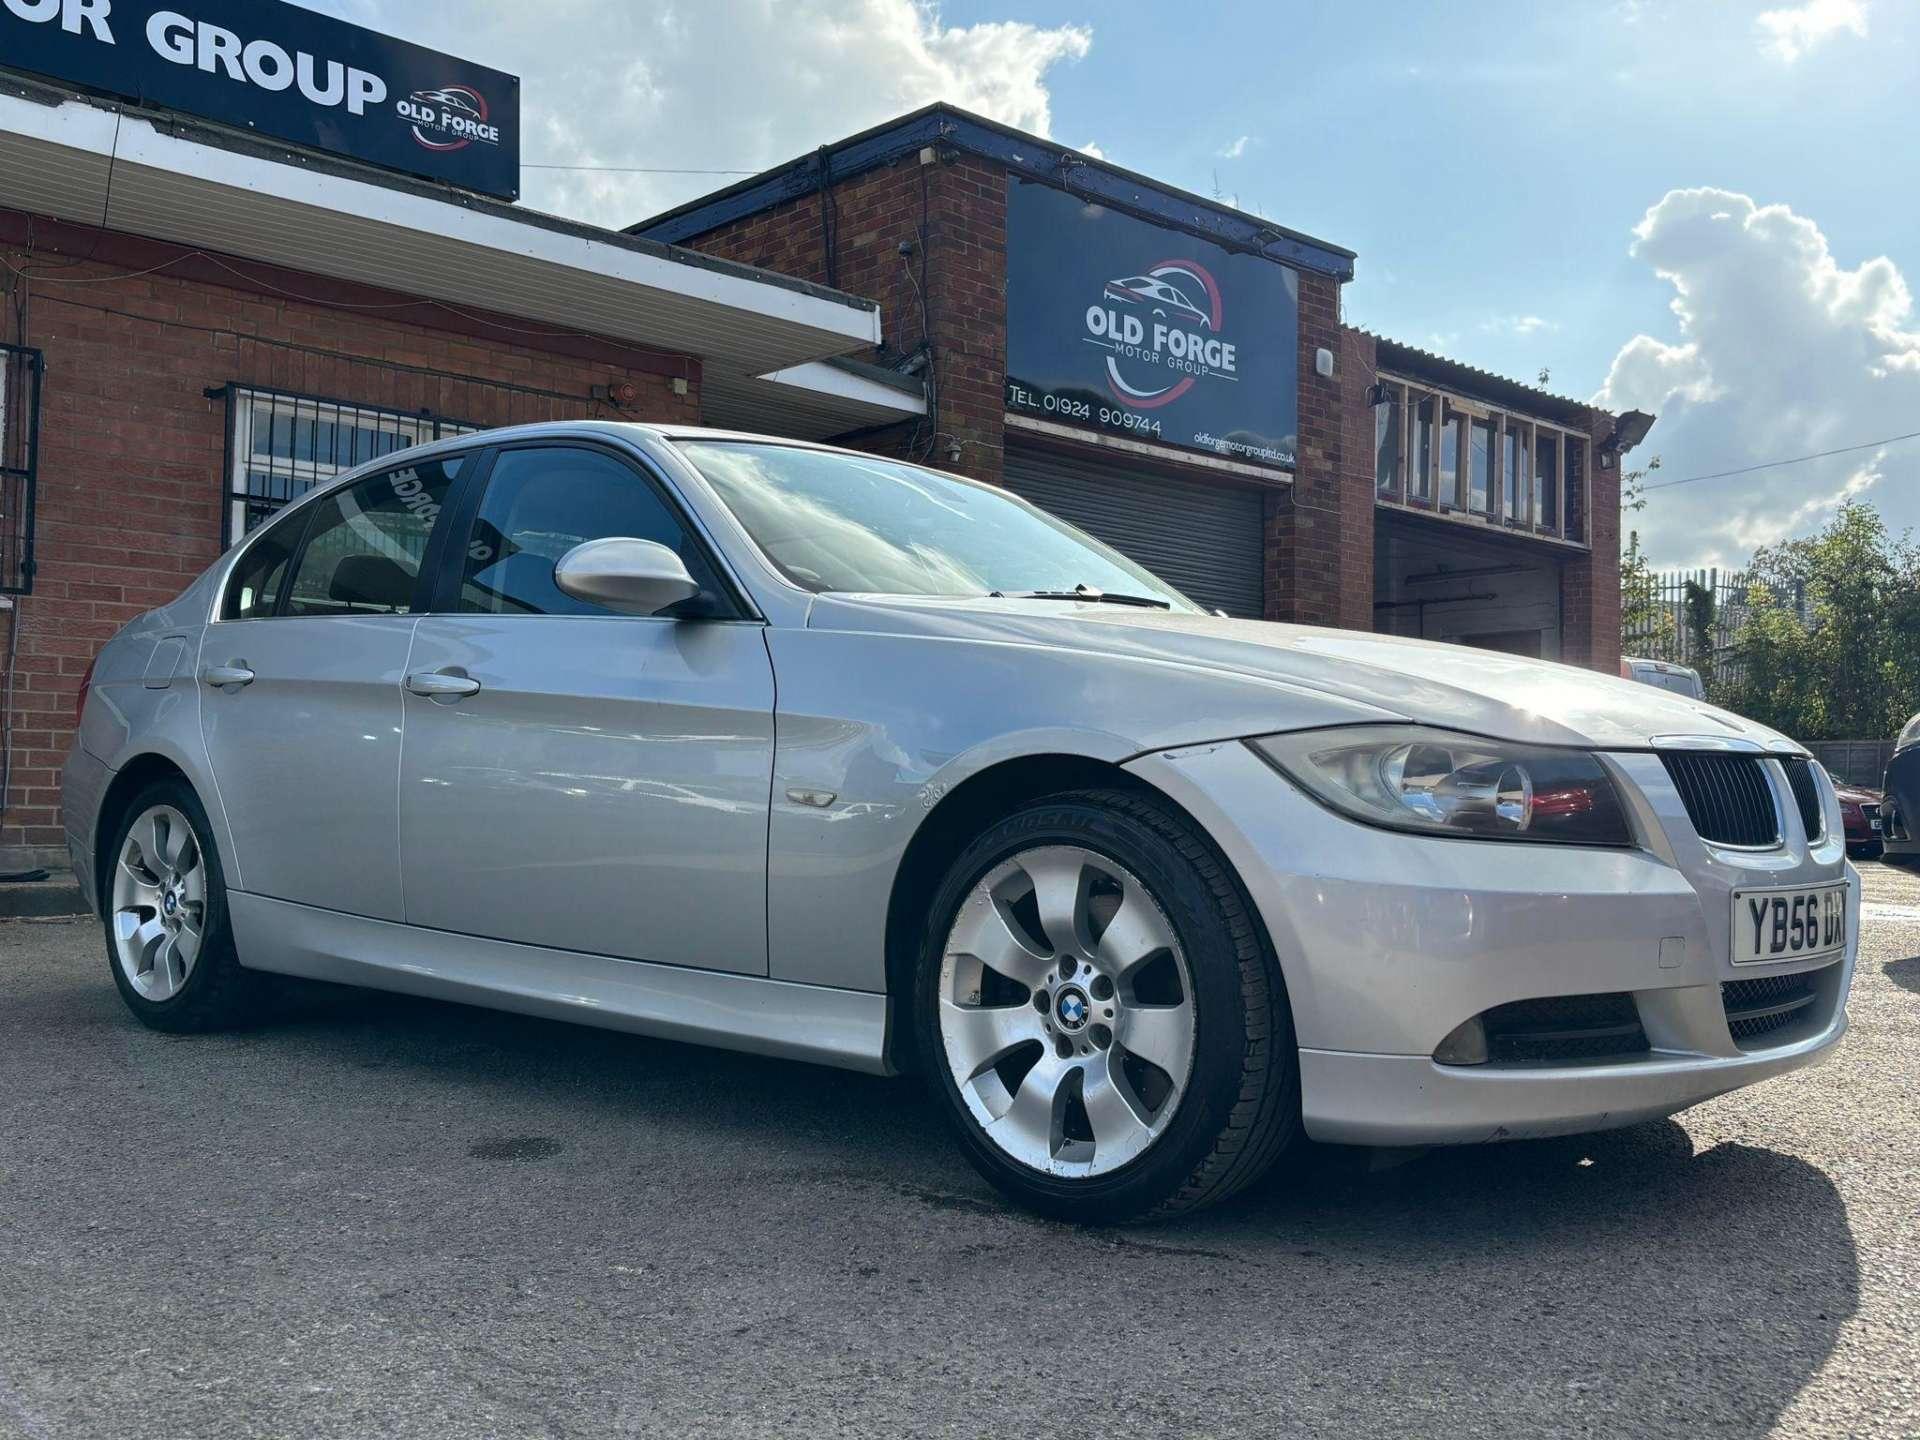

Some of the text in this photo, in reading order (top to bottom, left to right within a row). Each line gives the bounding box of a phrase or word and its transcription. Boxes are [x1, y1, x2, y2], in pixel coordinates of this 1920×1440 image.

[145, 10, 388, 116] GROUP
[396, 100, 499, 142] OLD FORGE
[417, 120, 479, 141] MOTOR GROUP
[1086, 305, 1236, 372] OLD FORGE
[1115, 343, 1209, 376] MOTOR GROUP
[1009, 385, 1161, 436] TEL. 01924 909744
[1748, 894, 1818, 955] YB56
